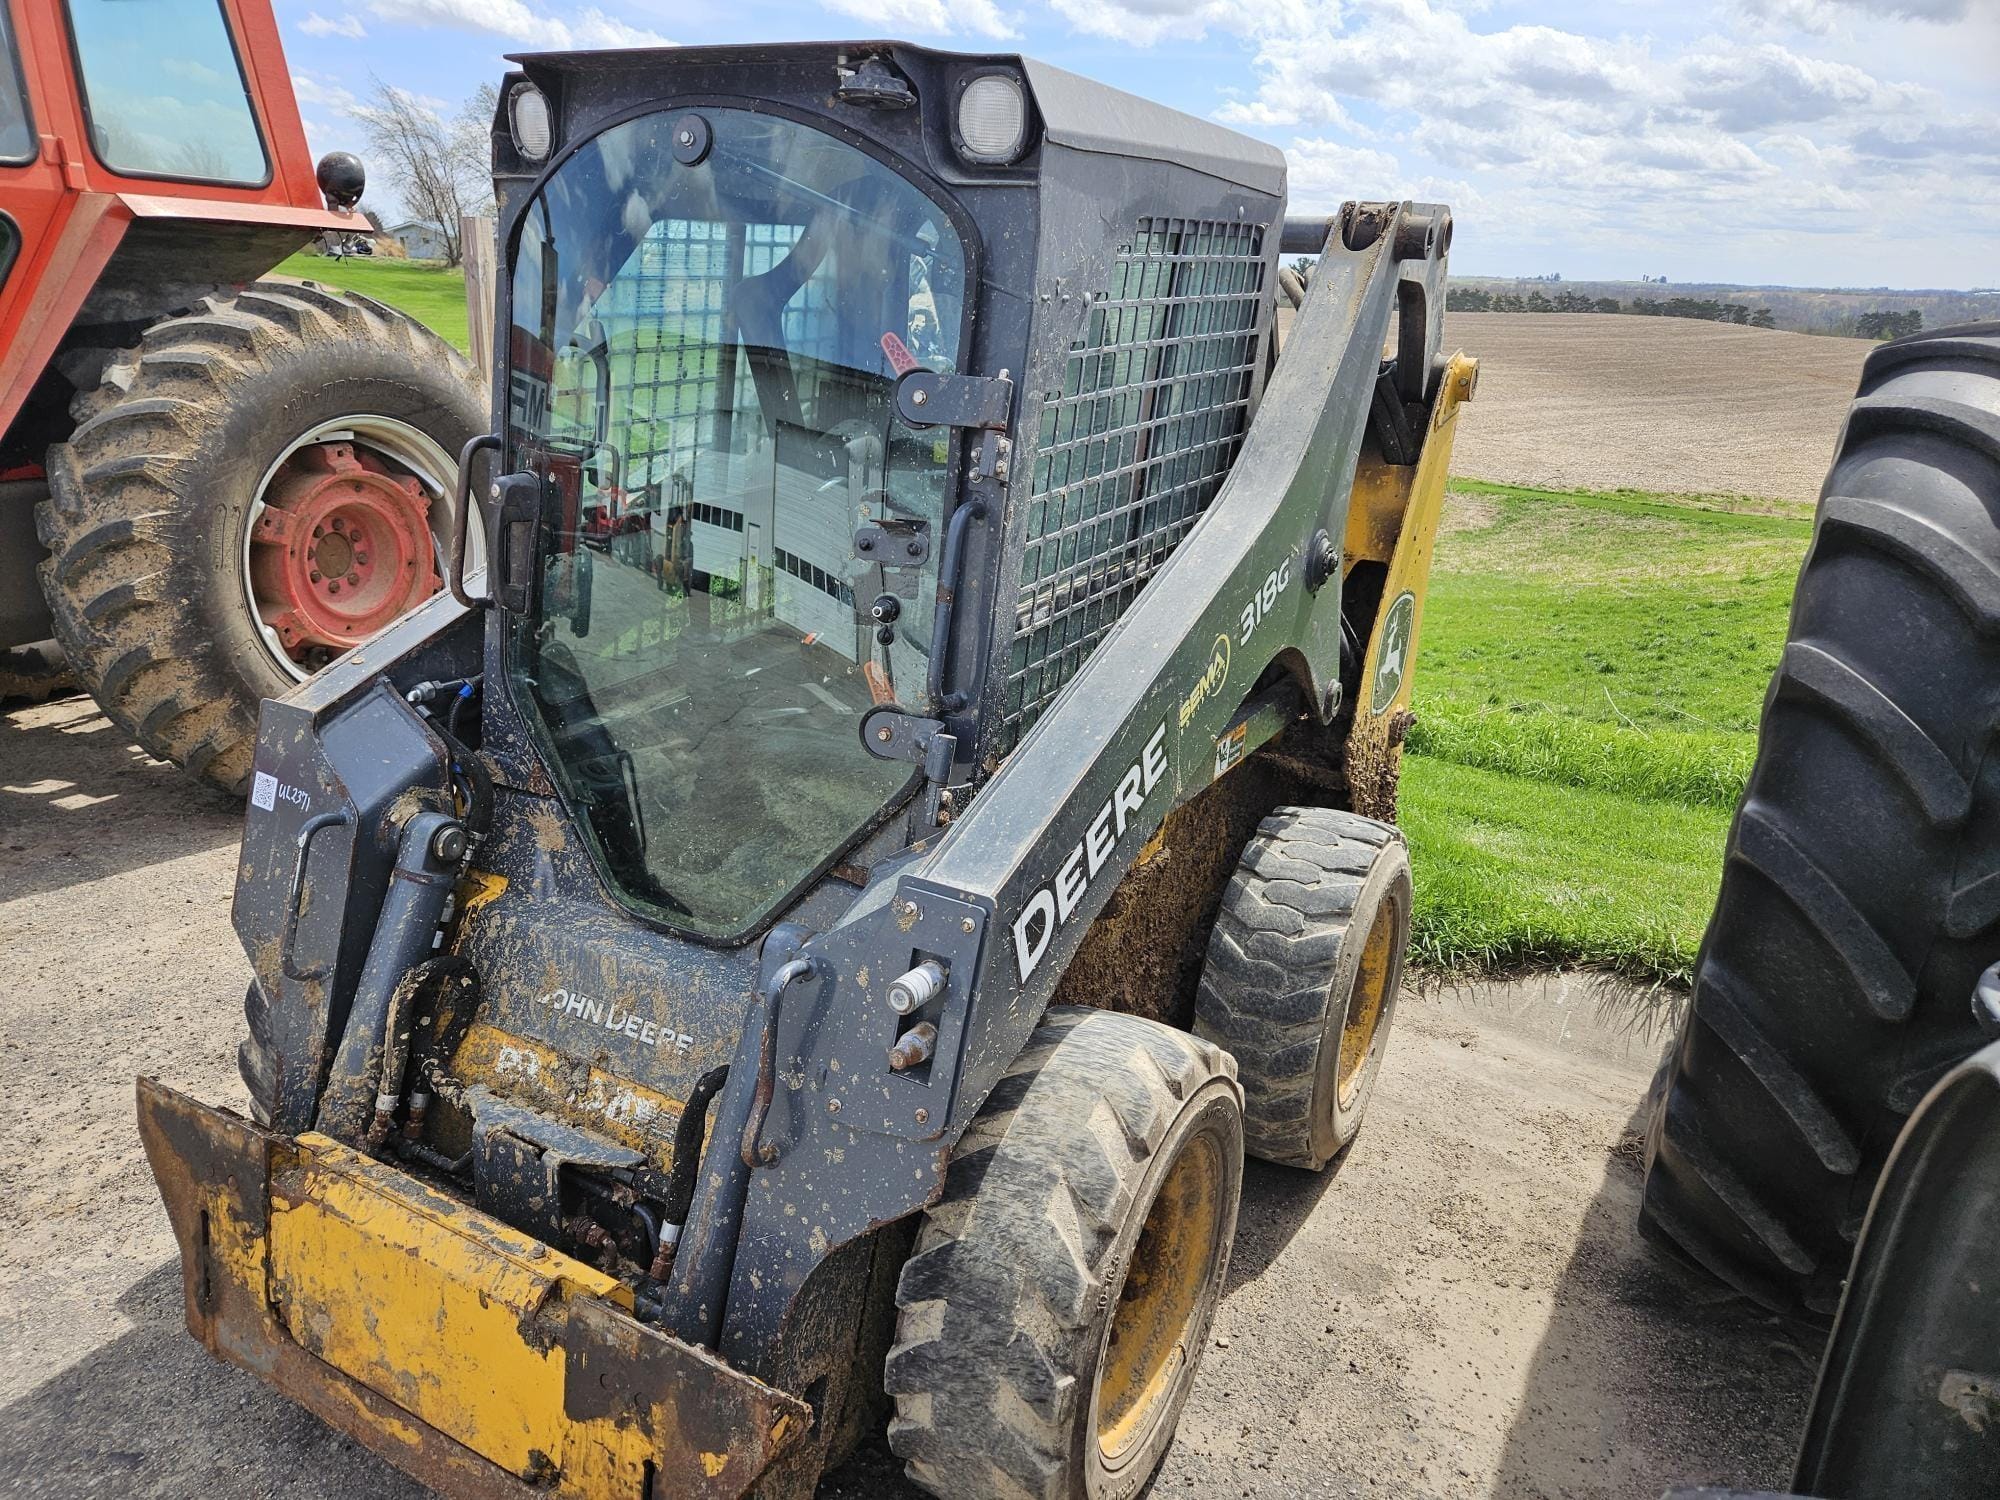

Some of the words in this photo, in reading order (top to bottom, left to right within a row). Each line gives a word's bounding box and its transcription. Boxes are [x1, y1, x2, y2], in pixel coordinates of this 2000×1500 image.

[1240, 556, 1290, 647] 318G
[279, 783, 311, 812] UL2371
[1015, 721, 1169, 984] DEERE
